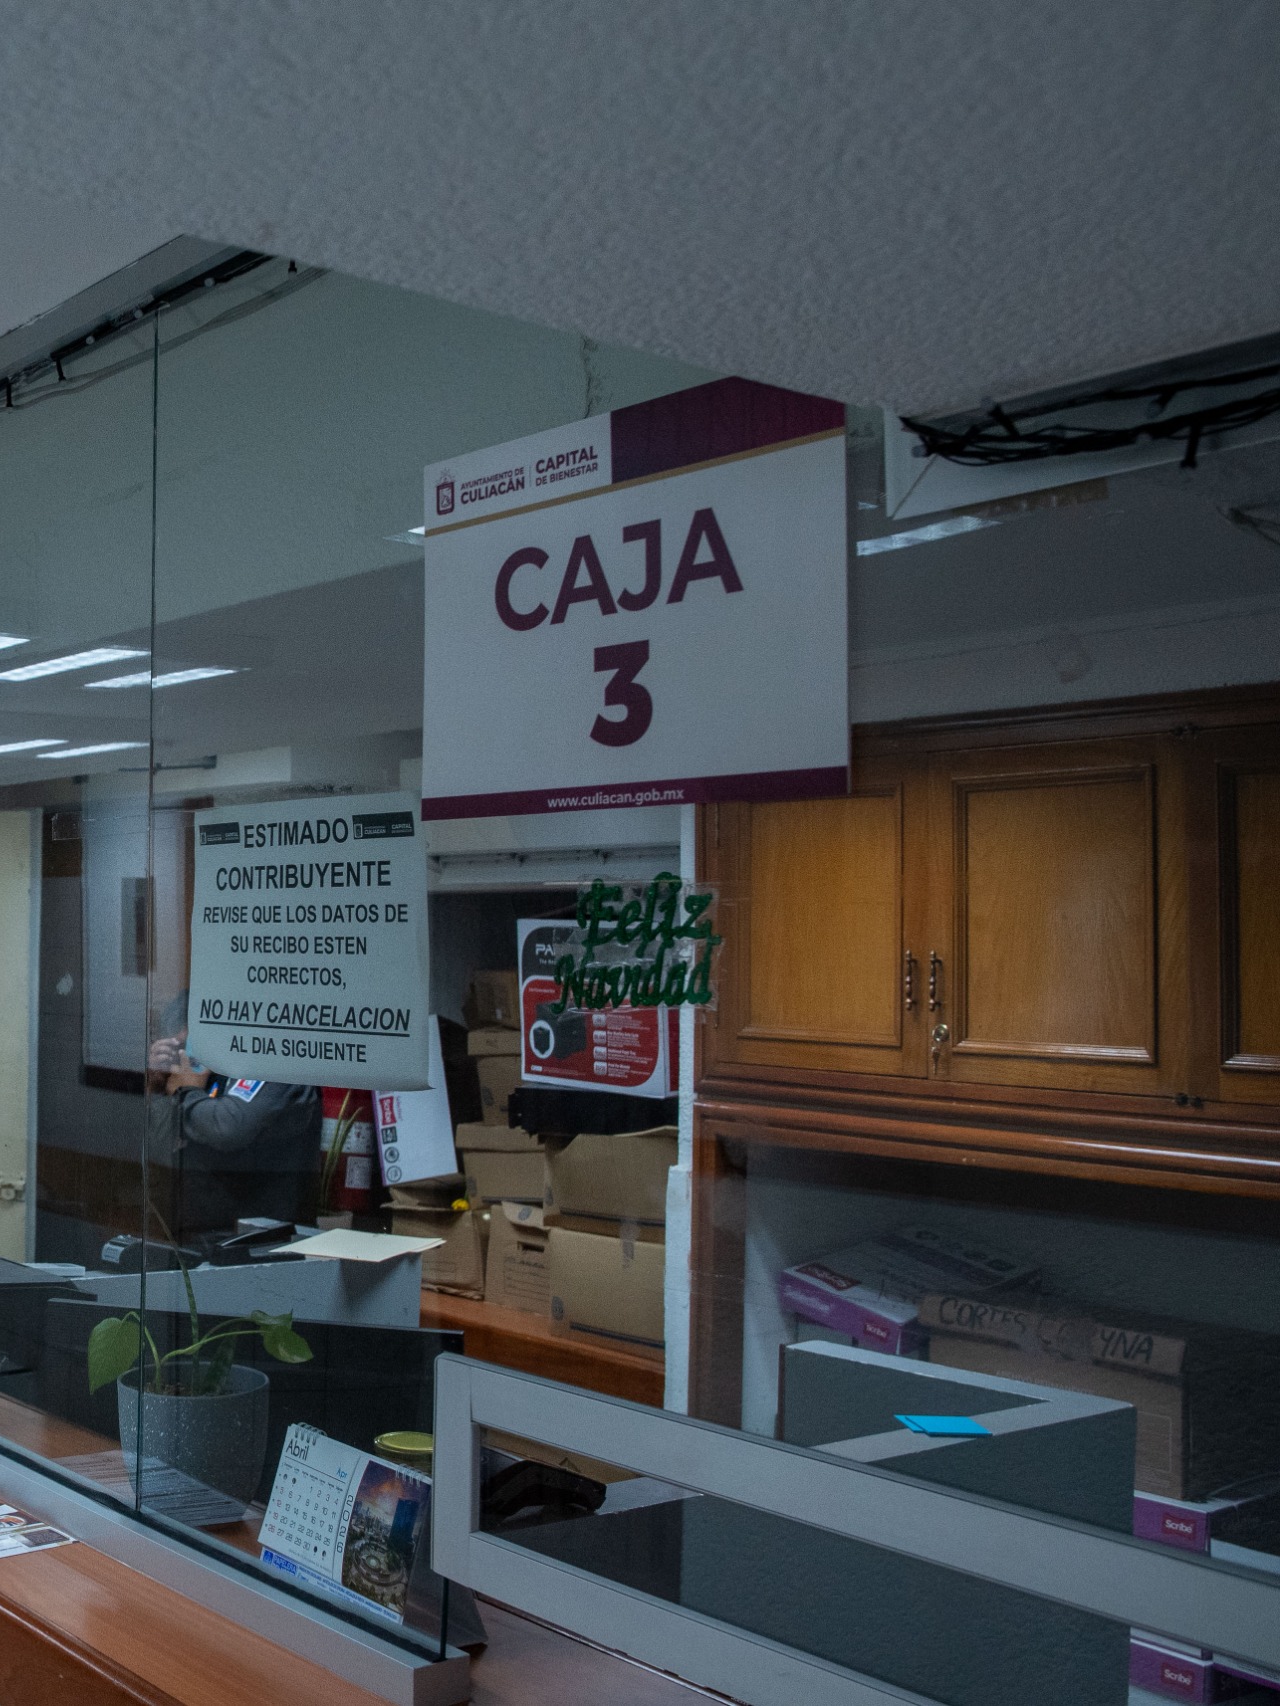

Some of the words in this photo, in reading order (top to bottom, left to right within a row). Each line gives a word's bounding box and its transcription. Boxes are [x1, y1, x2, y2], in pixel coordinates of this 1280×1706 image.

[536, 445, 598, 474] CAPITAL
[461, 470, 513, 490] AYUNTAMIENTO
[515, 467, 524, 477] DE
[536, 476, 548, 487] DE
[550, 462, 598, 483] BIENESTAR
[461, 476, 525, 504] CULIACÁN
[495, 507, 744, 631] CAJA
[590, 639, 653, 747] 3
[547, 788, 685, 808] www.culiacan.gob.mx
[243, 818, 349, 849] ESTIMADO
[216, 860, 391, 891] CONTRIBUYENTE
[203, 906, 248, 924] REVISE
[251, 905, 282, 924] QUE
[286, 905, 317, 923] LOS
[322, 904, 379, 923] DATOS
[385, 904, 408, 923] DE
[231, 935, 249, 953] SU
[253, 936, 309, 954] RECIBO
[313, 936, 367, 955] ESTEN
[247, 966, 347, 990] CORRECTOS,
[550, 922, 720, 1014] Navidad
[200, 998, 223, 1020] NO
[228, 1000, 263, 1022] HAY
[267, 1002, 410, 1031] CANCELACION
[230, 1035, 248, 1053] AL
[252, 1036, 277, 1055] DIA
[281, 1039, 367, 1063] SIGUIENTE
[866, 1324, 887, 1338] Scribe
[286, 1439, 310, 1461] Abril
[272, 1512, 279, 1521] 19
[279, 1516, 288, 1525] 20
[289, 1520, 296, 1529] 21
[297, 1524, 305, 1533] 22
[305, 1528, 313, 1537] 23
[323, 1536, 331, 1547] 25
[284, 1503, 291, 1512] 13
[293, 1507, 299, 1516] 14
[302, 1511, 308, 1520] 15
[310, 1516, 317, 1525] 16
[319, 1520, 325, 1528] 17
[327, 1524, 334, 1533] 18
[1165, 1519, 1193, 1534] Scribe
[276, 1528, 285, 1537] 27
[285, 1532, 293, 1542] 28
[294, 1536, 302, 1546] 29
[302, 1541, 311, 1550] 30
[1164, 1669, 1191, 1686] Scribe
